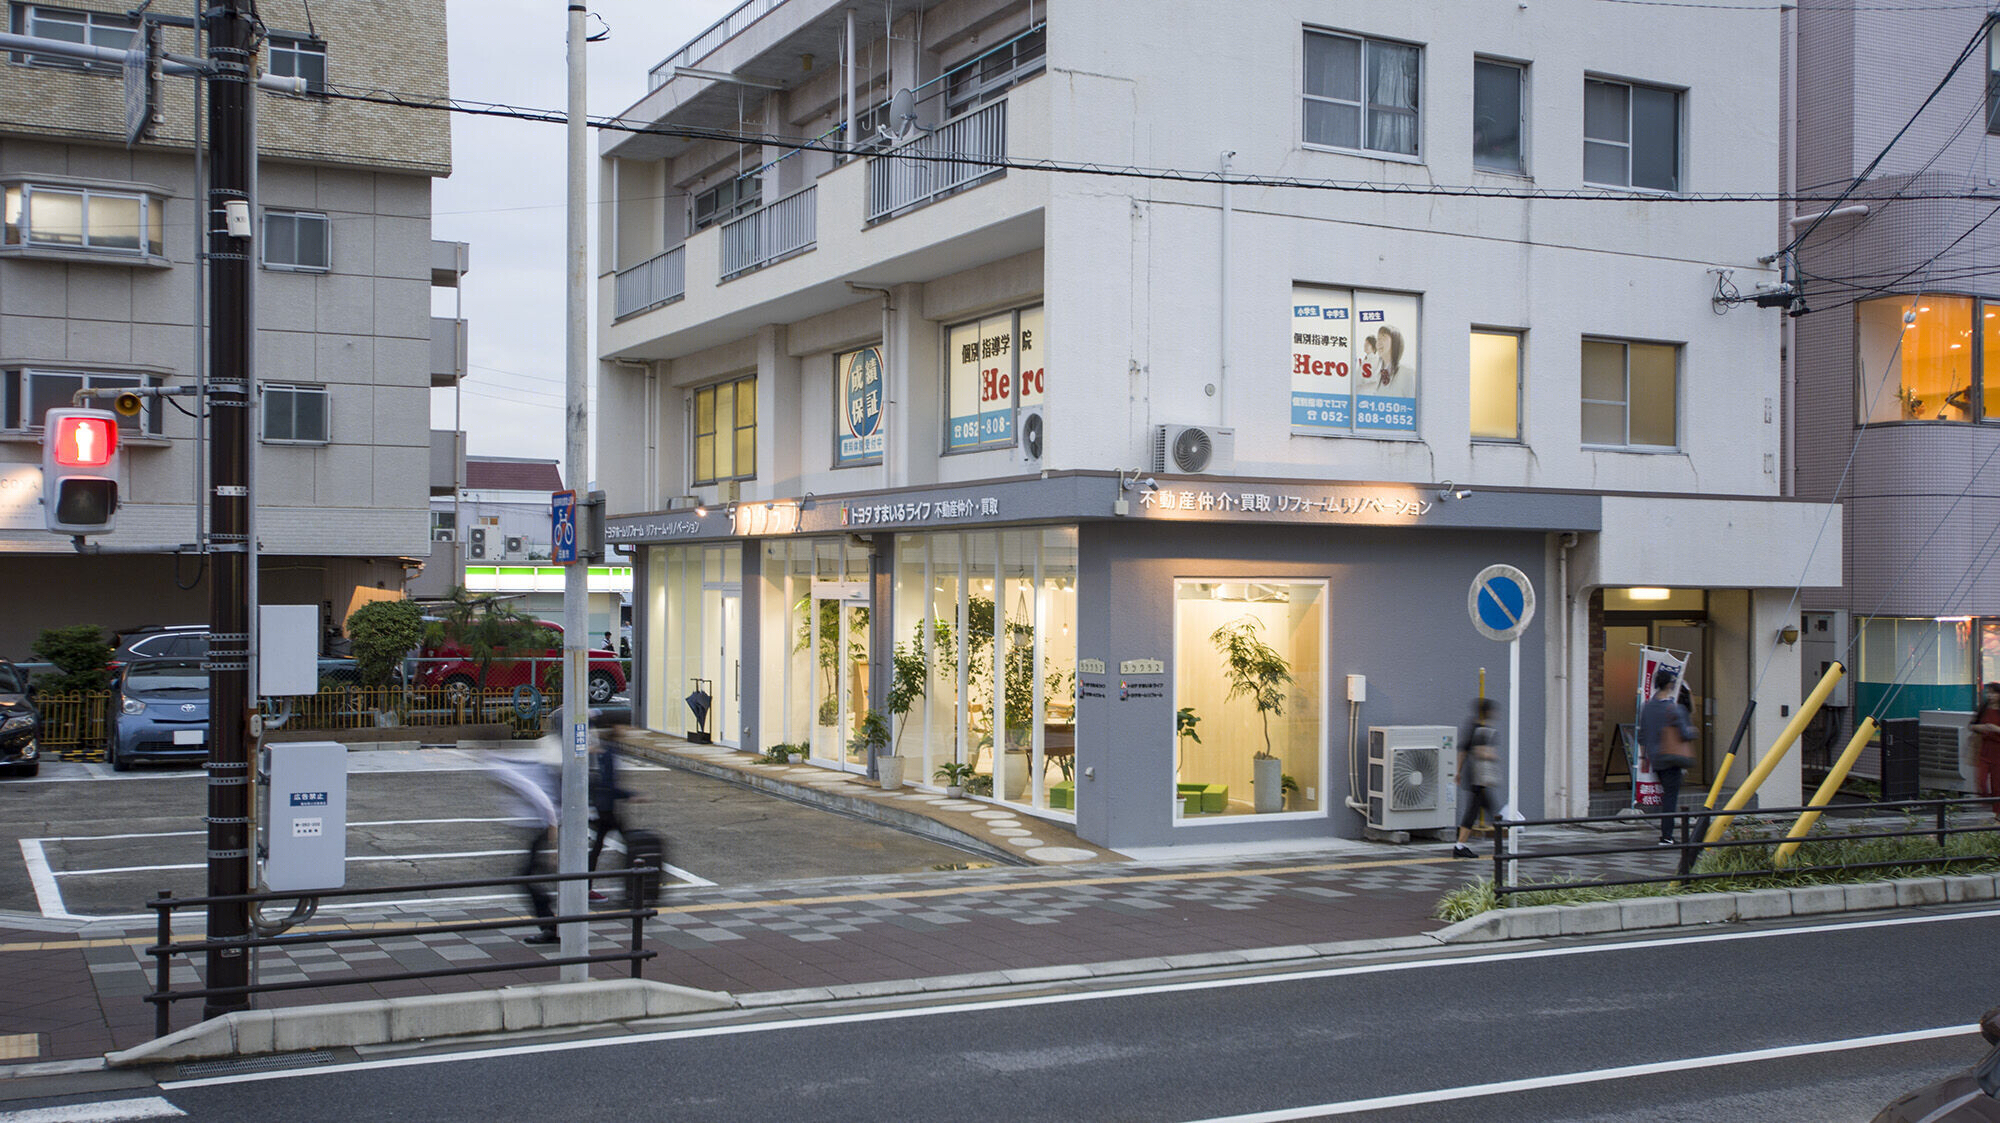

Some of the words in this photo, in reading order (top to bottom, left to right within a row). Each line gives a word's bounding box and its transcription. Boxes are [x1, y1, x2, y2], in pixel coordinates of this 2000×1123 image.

[1297, 308, 1317, 316] 小学生
[1326, 310, 1345, 319] 中学生
[1293, 333, 1348, 348] 個別指導学院
[851, 358, 878, 392] 成績
[851, 390, 879, 426] 保証
